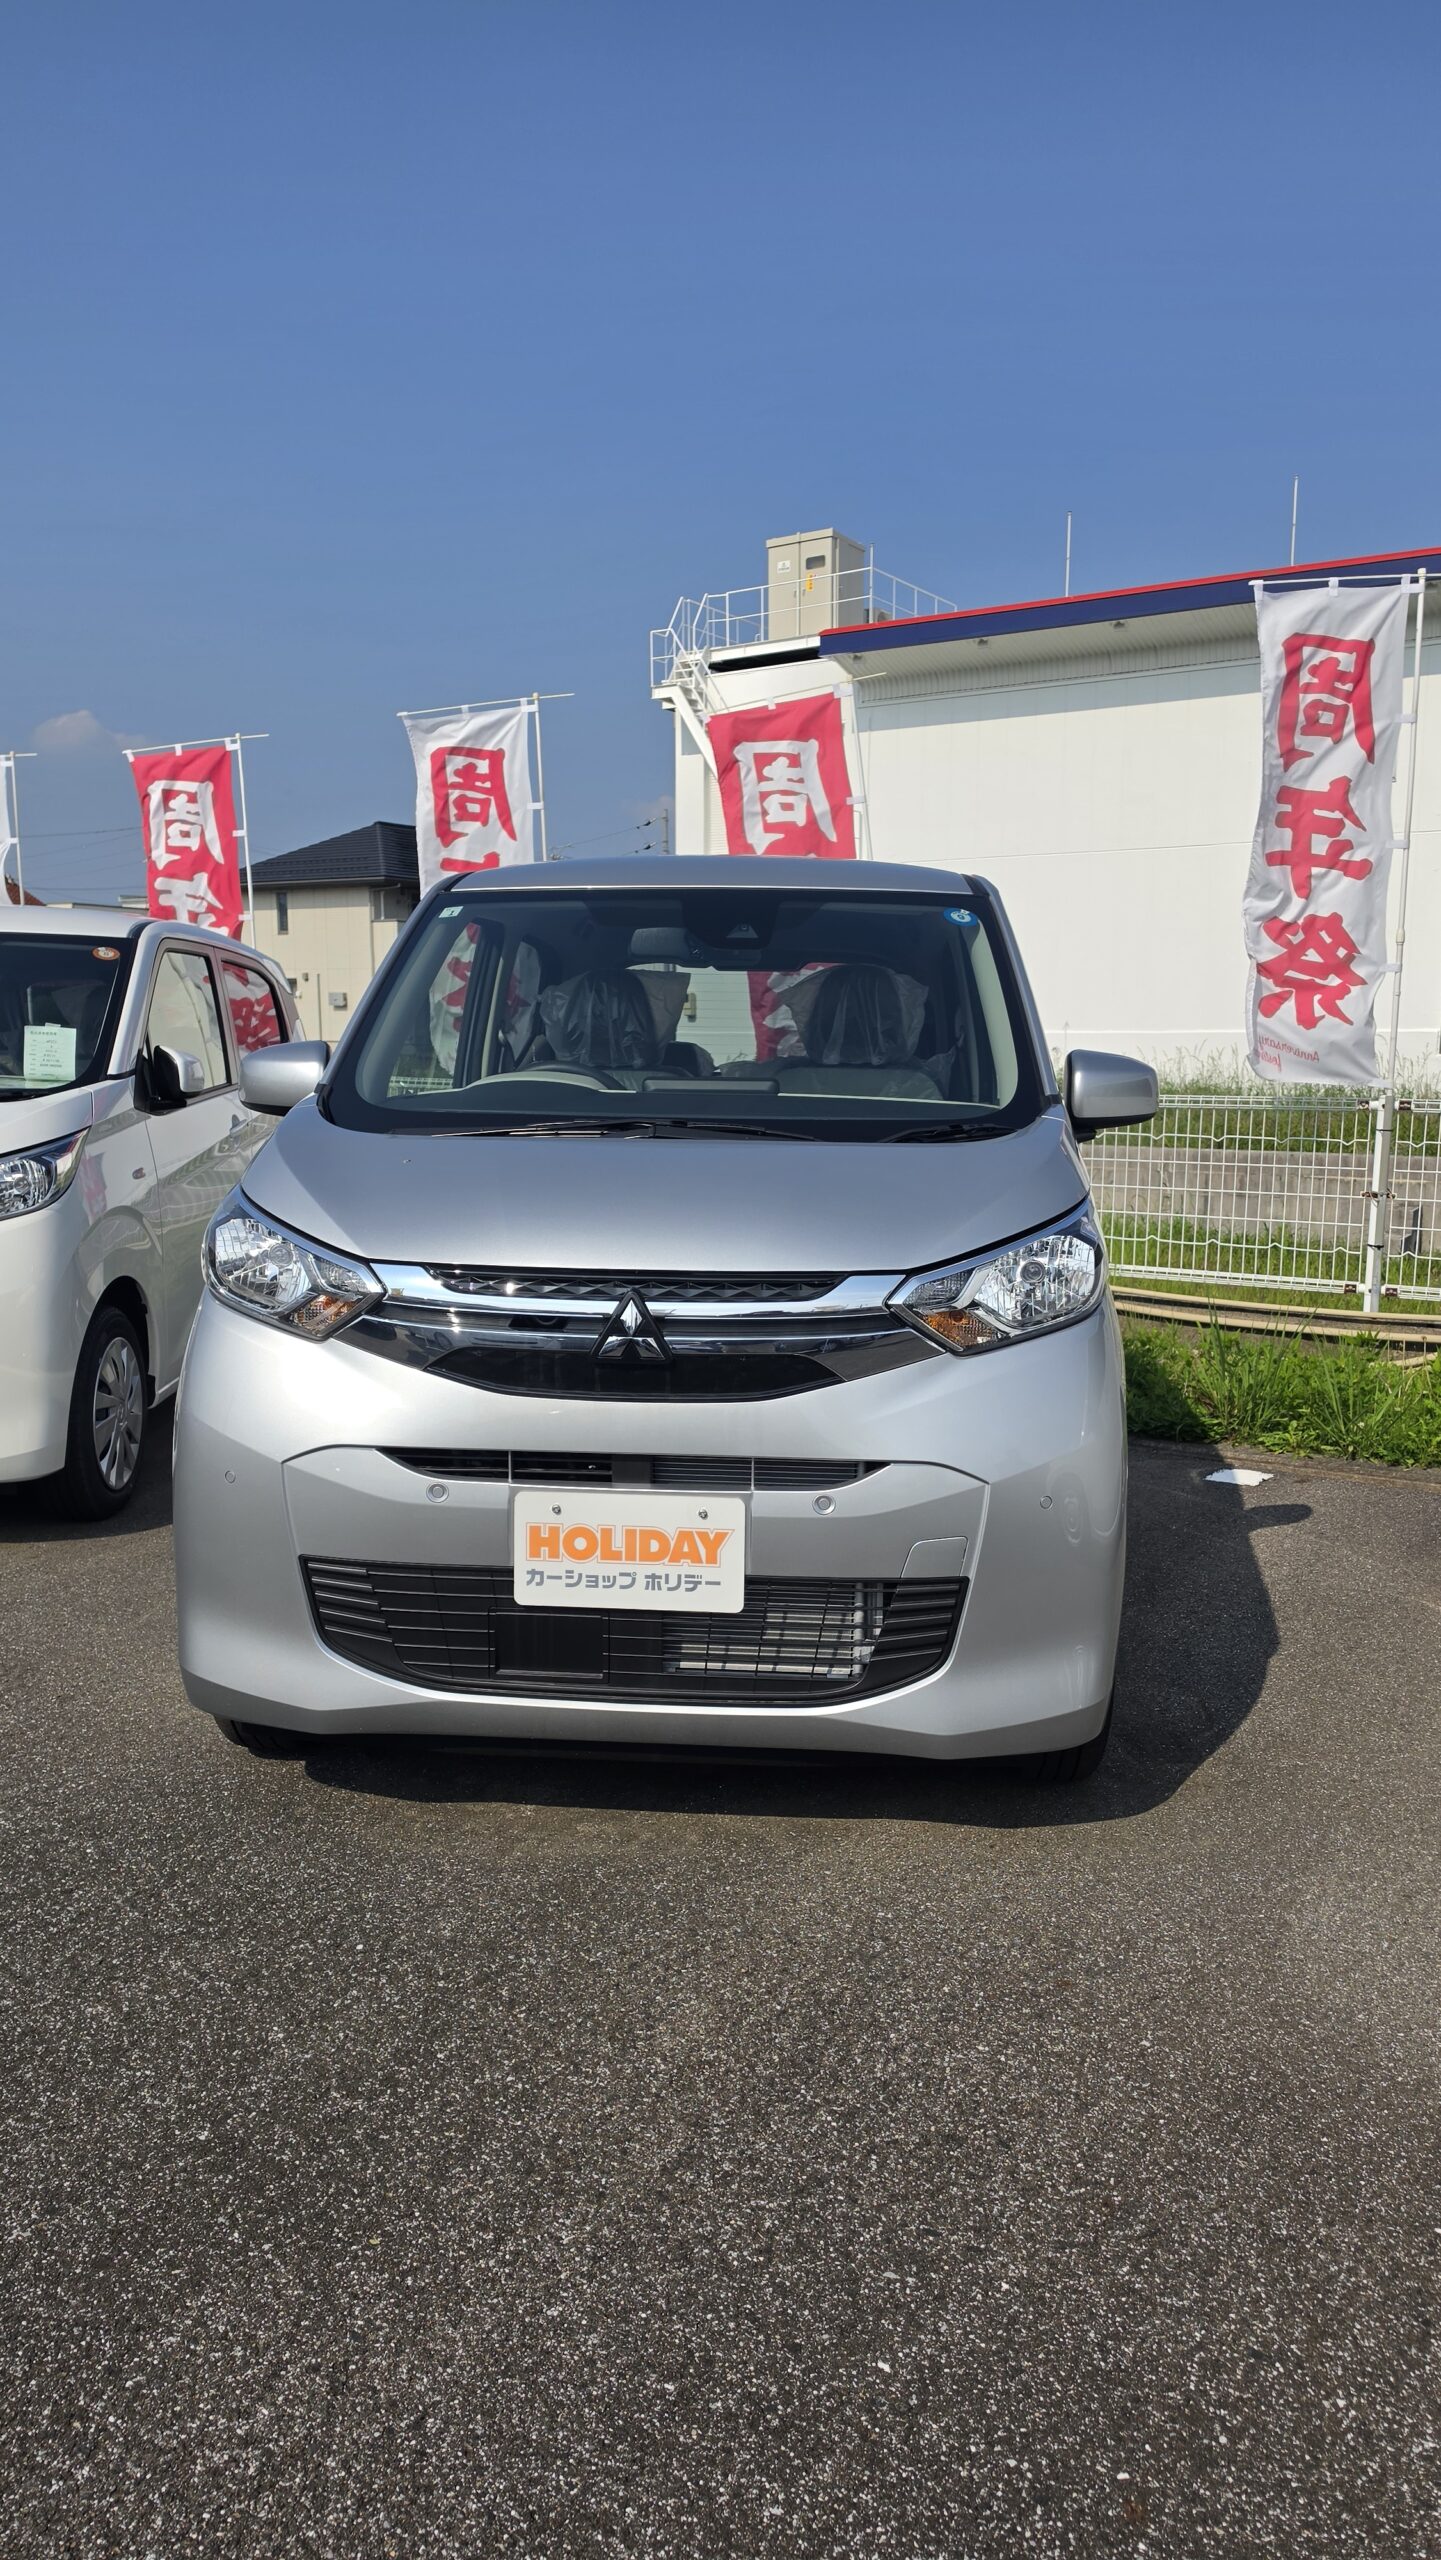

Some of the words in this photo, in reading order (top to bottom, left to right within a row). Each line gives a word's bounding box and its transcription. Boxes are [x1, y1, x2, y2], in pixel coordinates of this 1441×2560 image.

[526, 1522, 735, 1568] HOLIDAY
[525, 1568, 637, 1590] カーショップ
[644, 1572, 721, 1593] ホリデー
